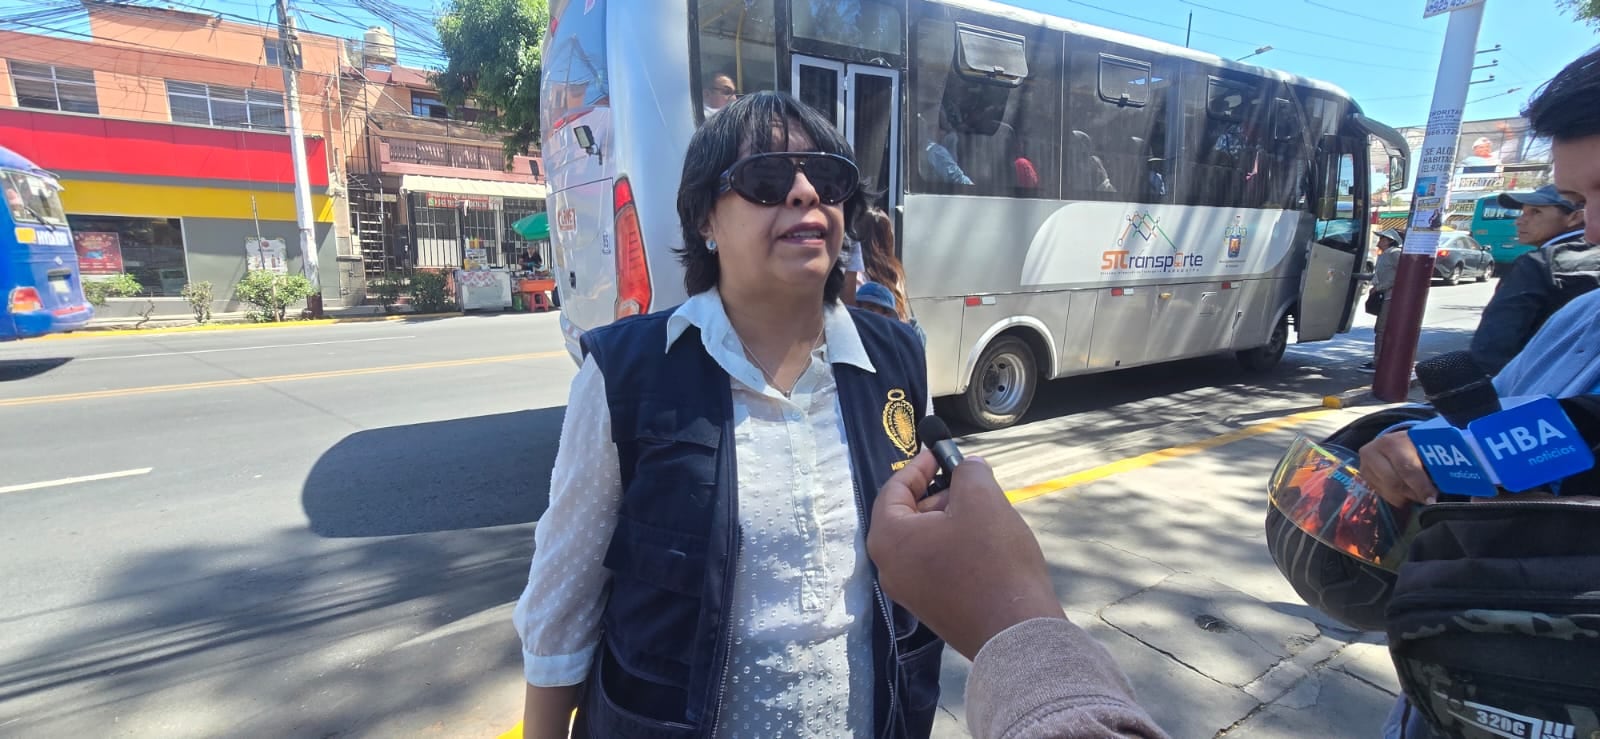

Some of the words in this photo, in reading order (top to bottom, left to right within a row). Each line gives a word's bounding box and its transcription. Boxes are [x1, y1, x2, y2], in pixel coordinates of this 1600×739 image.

[1484, 418, 1568, 461] HBA
[1418, 444, 1473, 467] HBA
[1528, 444, 1577, 466] noticias
